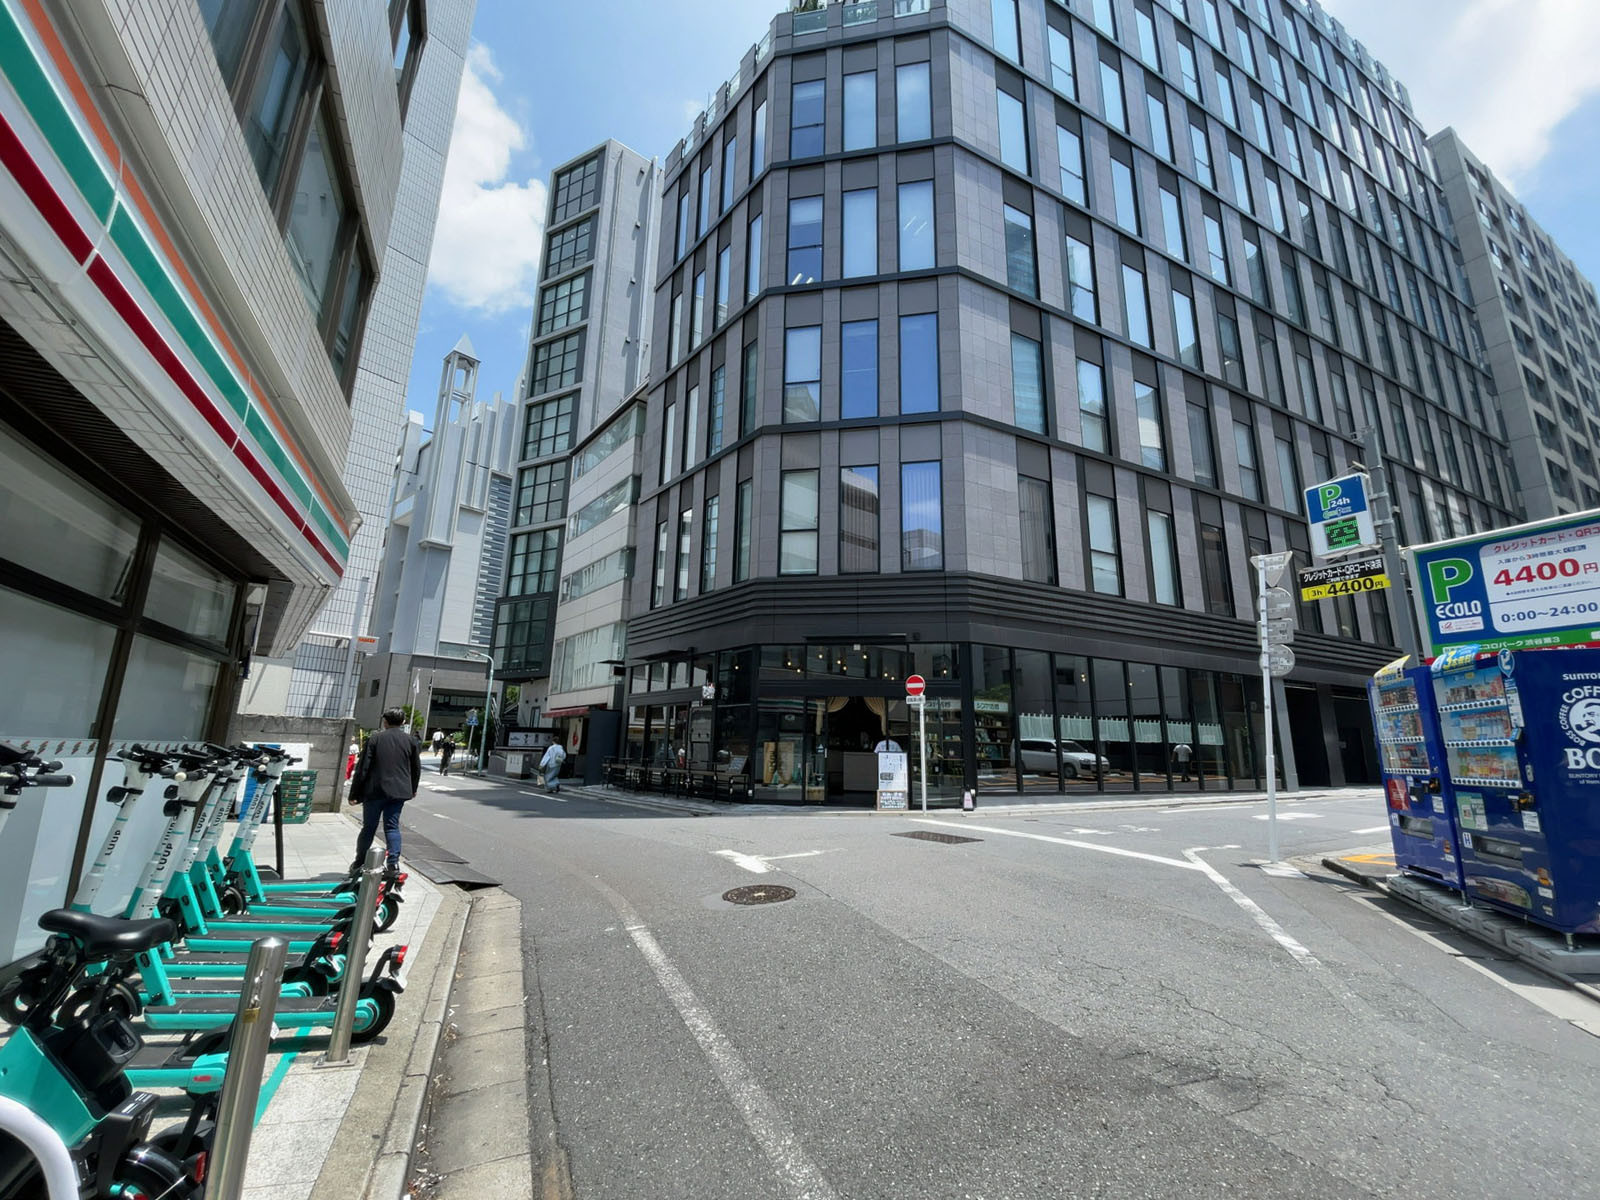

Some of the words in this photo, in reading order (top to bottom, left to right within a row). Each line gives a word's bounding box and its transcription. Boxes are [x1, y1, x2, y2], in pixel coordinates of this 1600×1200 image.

[1319, 484, 1342, 511] P
[1330, 497, 1350, 508] 24h
[1427, 557, 1474, 605] P
[1311, 589, 1323, 597] 3h
[1435, 600, 1482, 619] ECOLO
[1559, 704, 1570, 730] COFFEE
[1566, 730, 1586, 747] BOSS
[213, 807, 225, 827] LUUP
[255, 800, 265, 819] LUUP
[195, 811, 207, 833] LUUP
[104, 829, 121, 856] LUUP
[156, 842, 173, 871] LUUP
